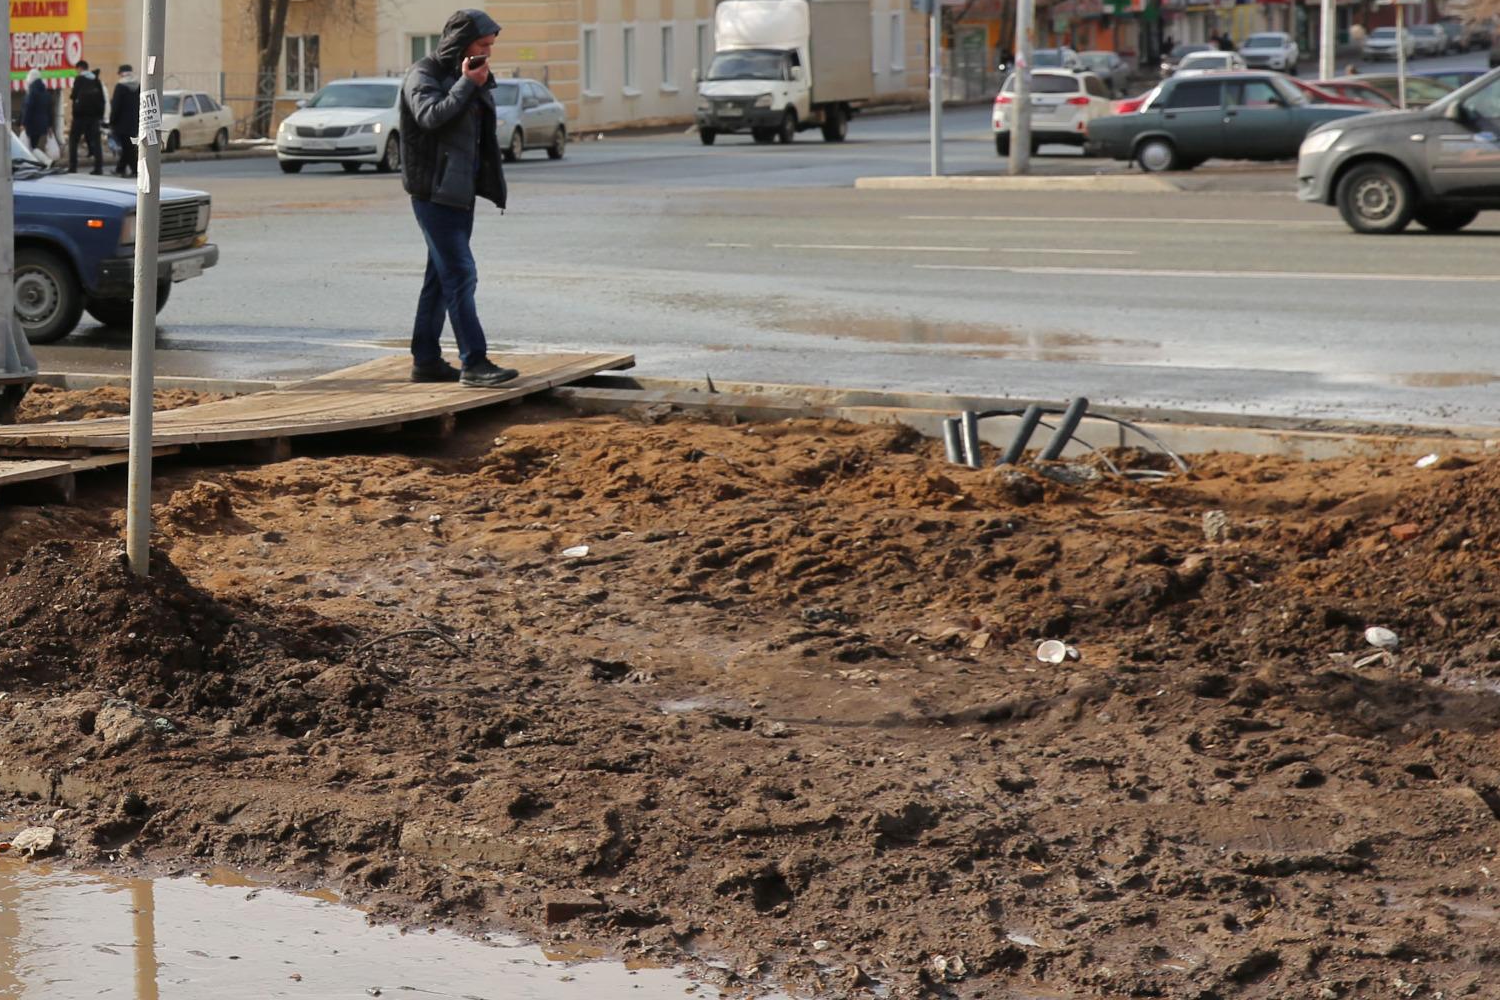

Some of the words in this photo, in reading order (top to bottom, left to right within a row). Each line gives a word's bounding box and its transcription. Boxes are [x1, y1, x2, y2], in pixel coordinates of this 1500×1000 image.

[12, 31, 64, 50] БЕЛАРУСЬ
[13, 50, 64, 68] ПРОДУКТ
[140, 108, 158, 117] СТРО
